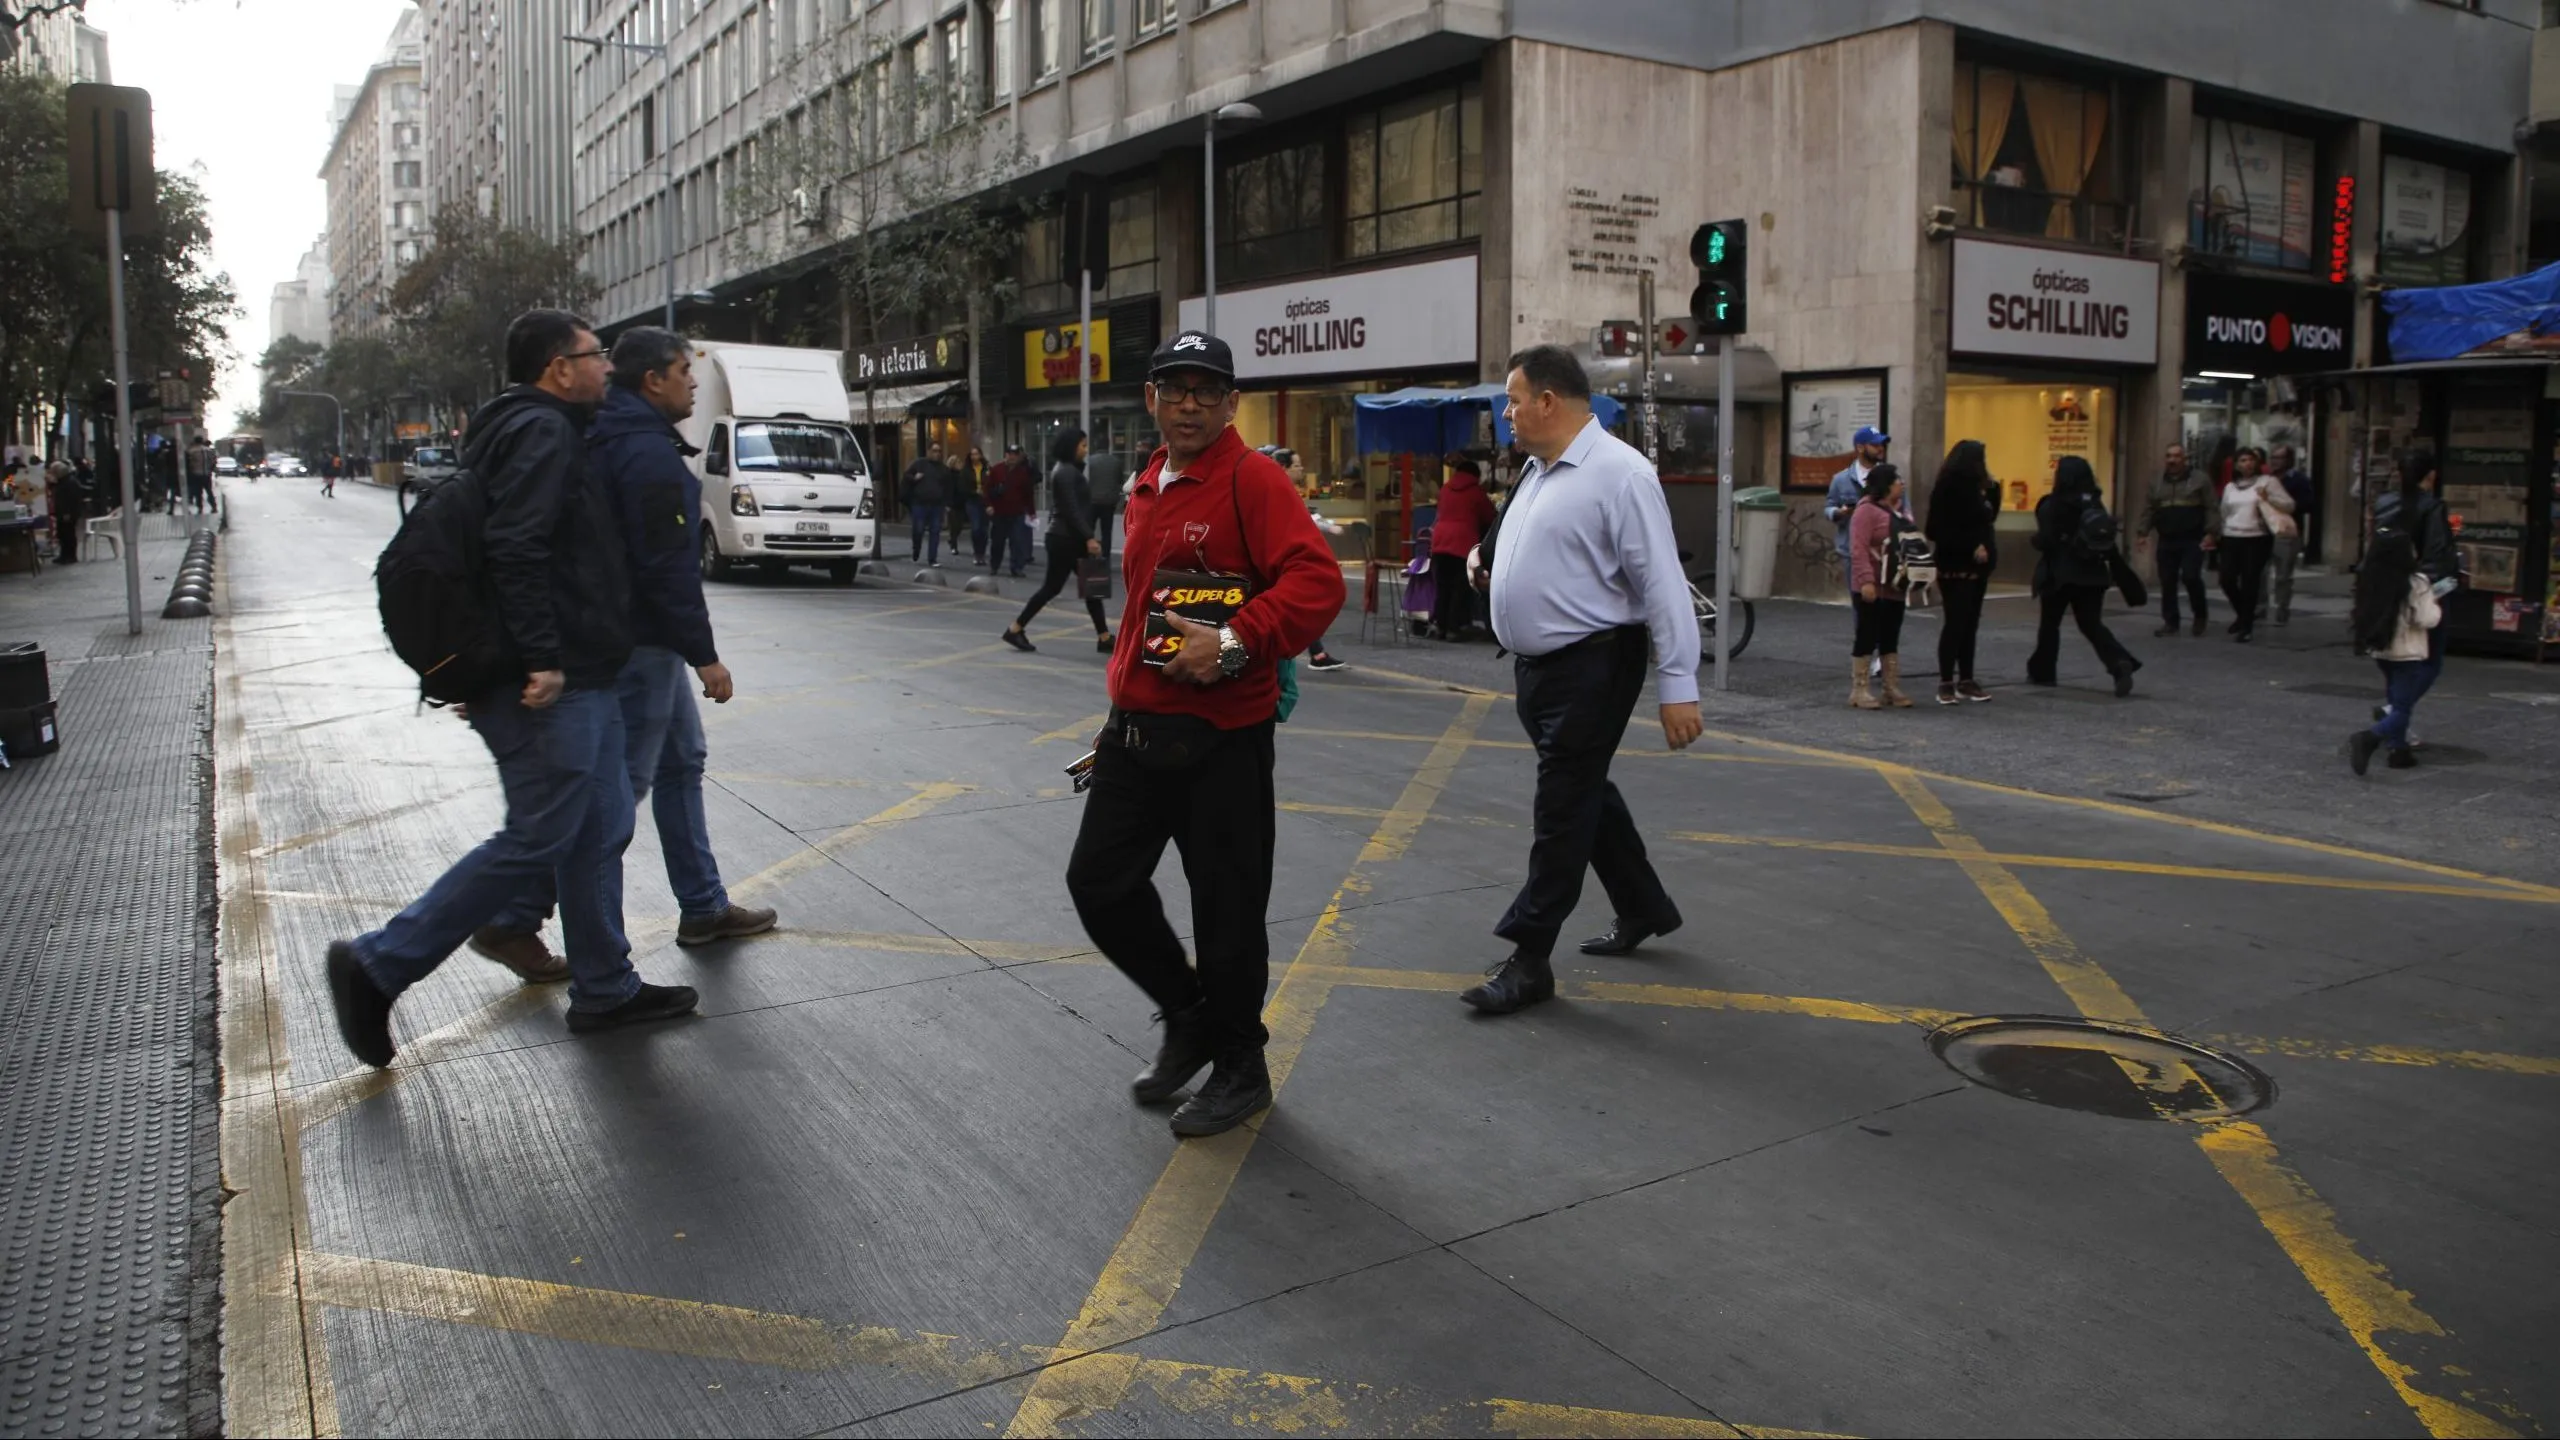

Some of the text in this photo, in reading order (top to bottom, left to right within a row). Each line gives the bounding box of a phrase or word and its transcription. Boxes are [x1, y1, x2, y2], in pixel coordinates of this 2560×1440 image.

[2032, 267, 2090, 295] ópticas
[1285, 297, 1331, 322] ópticas
[1988, 293, 2129, 340] SCHILLING
[1178, 335, 1203, 345] NIKE
[1255, 316, 1366, 357] SCHILLING
[2206, 315, 2343, 351] PUNTO VISION
[858, 342, 927, 379] Patelería
[1168, 589, 1224, 606] SUPER
[1223, 588, 1243, 605] 8
